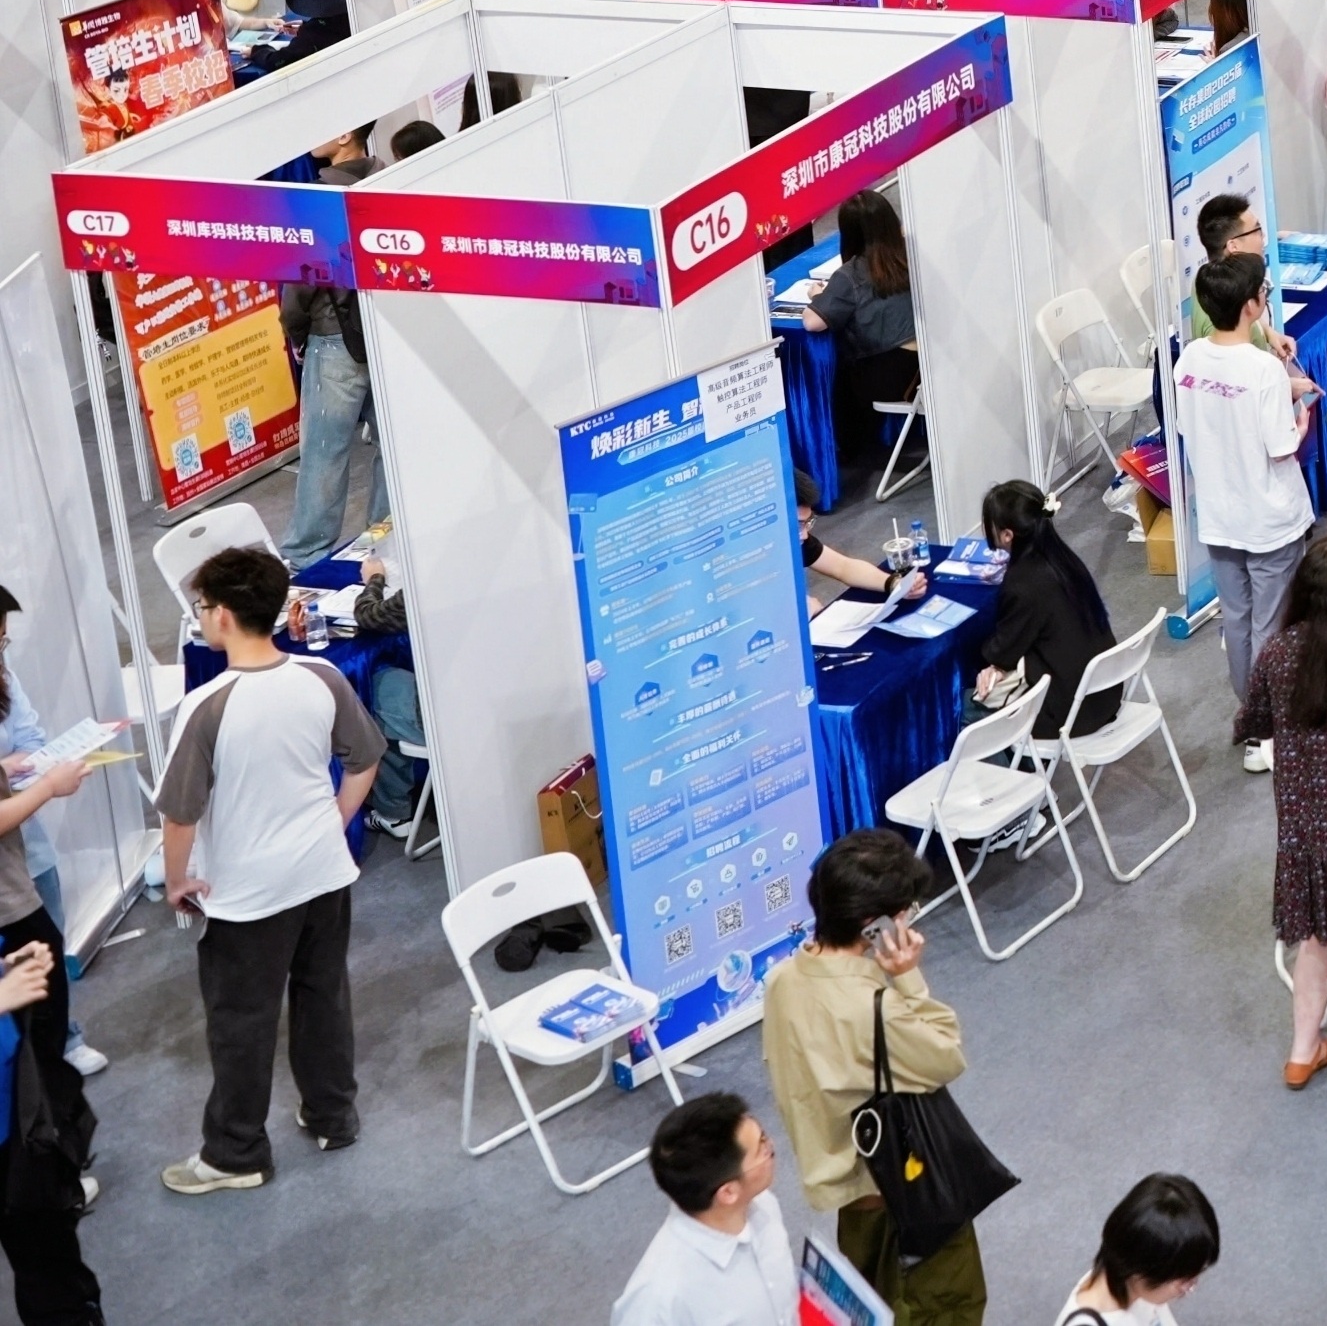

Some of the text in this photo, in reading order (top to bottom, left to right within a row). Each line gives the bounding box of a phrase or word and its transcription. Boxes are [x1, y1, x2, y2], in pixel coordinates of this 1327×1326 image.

[85, 11, 202, 80] 管培生计划
[139, 50, 228, 109] 春季校招
[1178, 61, 1244, 117] 长存集团2025届
[1189, 91, 1238, 131] 全球校园招聘
[689, 63, 976, 256] C16 深圳市康冠科技股份有限公司
[83, 213, 315, 246] C17 深圳库犸科技有限公司
[377, 231, 642, 265] C16 深圳市康冠科技股份有限公司
[707, 359, 775, 394] 高级音频算法工程师
[716, 375, 768, 404] 触控算法工程师
[726, 391, 763, 414] 产品工程师
[734, 406, 757, 424] 业务员
[570, 421, 591, 438] KTC
[591, 408, 678, 459] 焕彩新生
[664, 466, 699, 487] 公司简介
[682, 730, 742, 764] 全面的福利关怀
[705, 835, 741, 858] 招聘流程
